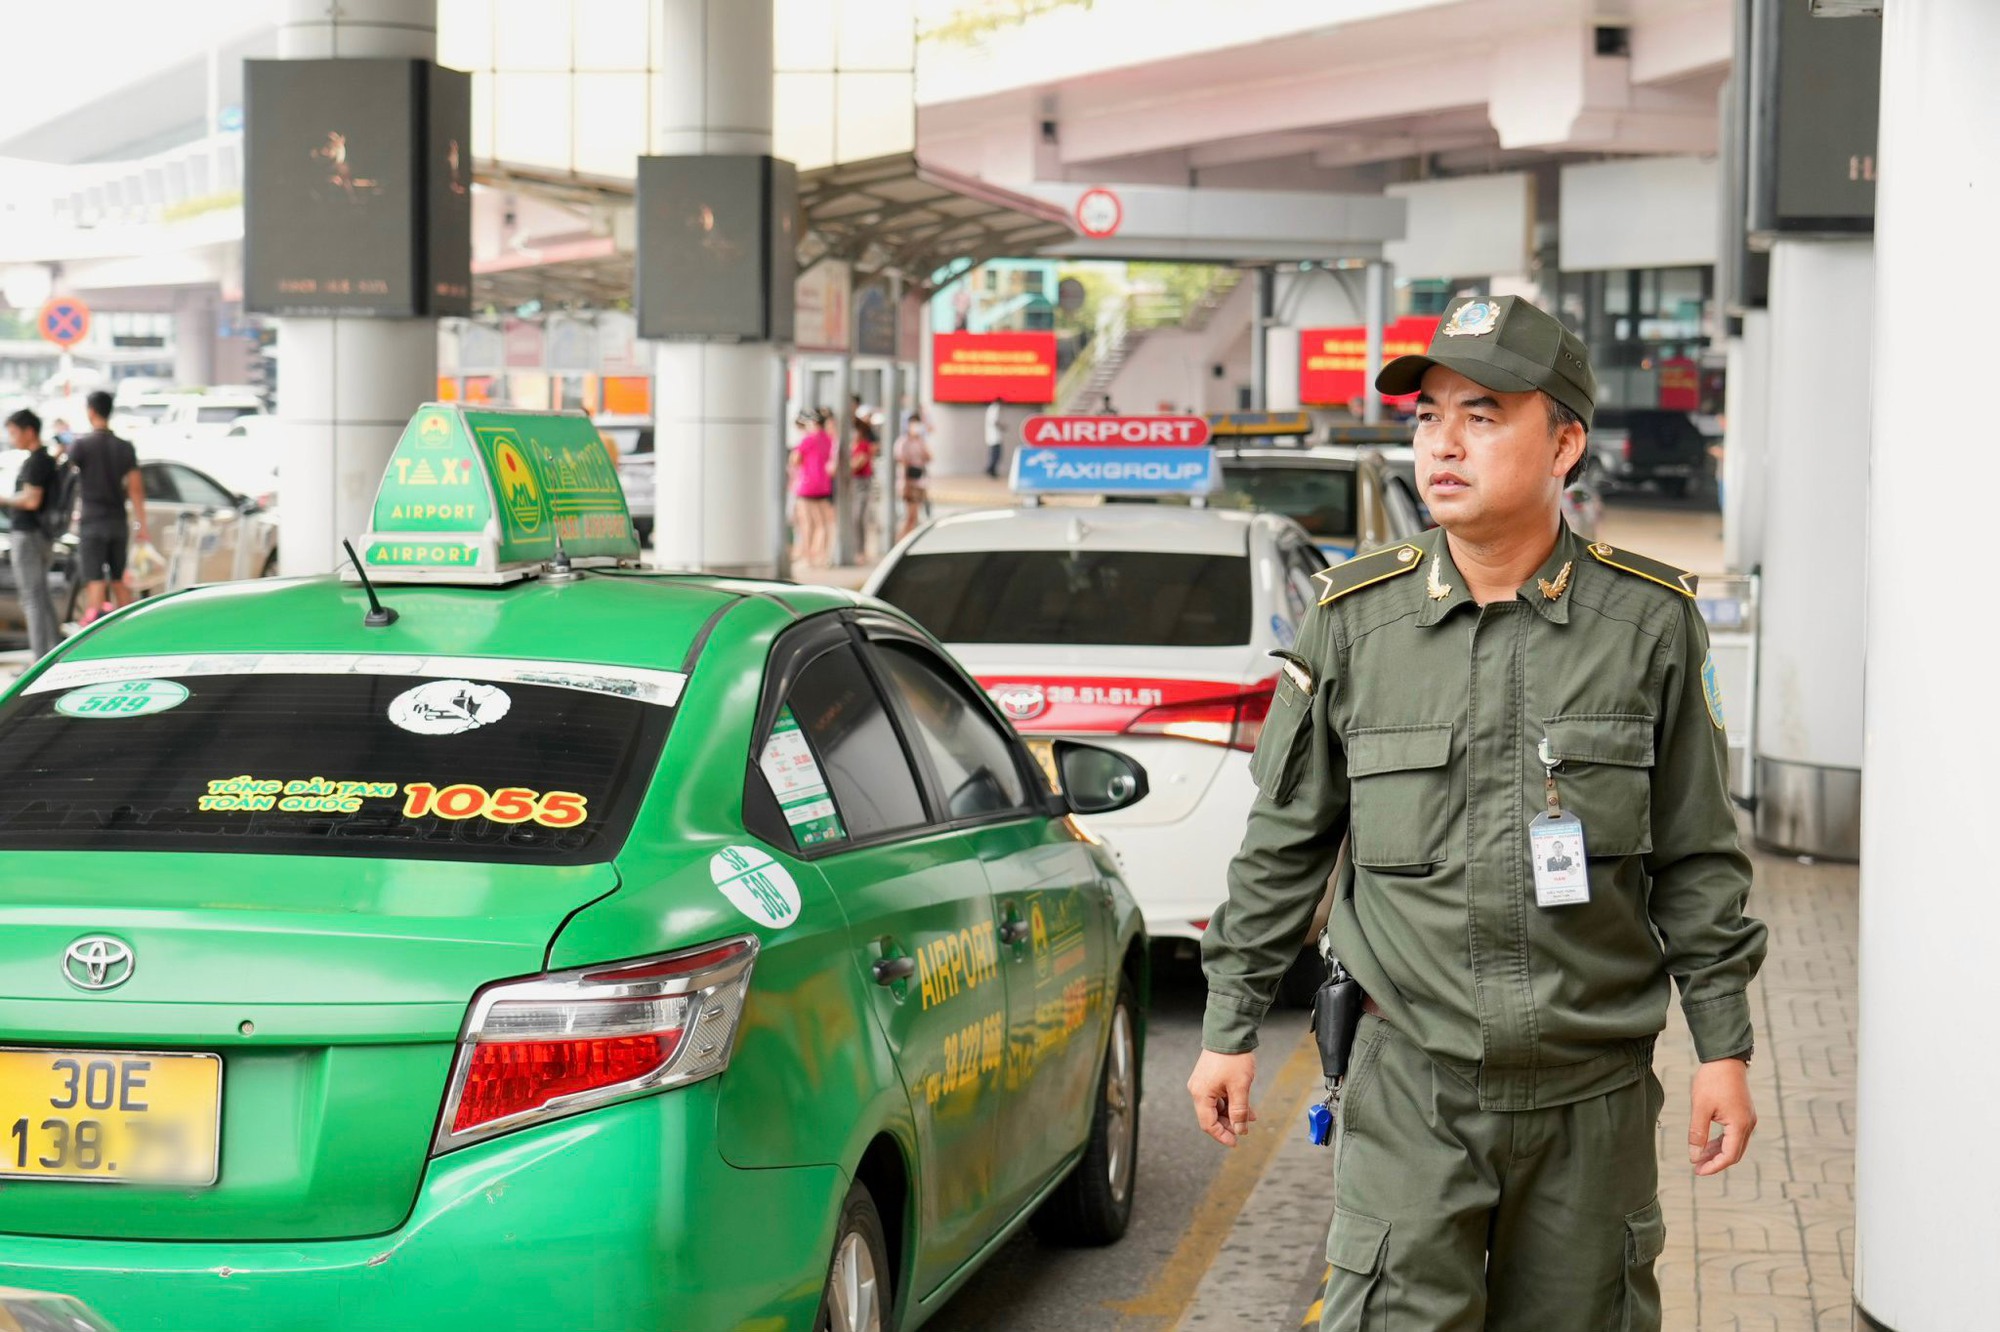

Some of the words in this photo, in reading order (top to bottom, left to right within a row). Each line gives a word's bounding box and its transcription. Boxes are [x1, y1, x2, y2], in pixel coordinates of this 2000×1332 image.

[1036, 420, 1198, 443] AIRPORT
[1044, 462, 1204, 481] TAXIGROUP
[391, 504, 476, 520] AIRPORT
[376, 546, 475, 563] AIRPORT
[118, 681, 153, 692] SB
[77, 696, 152, 713] 589
[336, 782, 398, 798] TAXI
[403, 782, 588, 828] 1055
[720, 848, 750, 872] SB
[740, 871, 792, 921] 589
[917, 919, 999, 1011] AIRPORT
[50, 1058, 151, 1112] 30E
